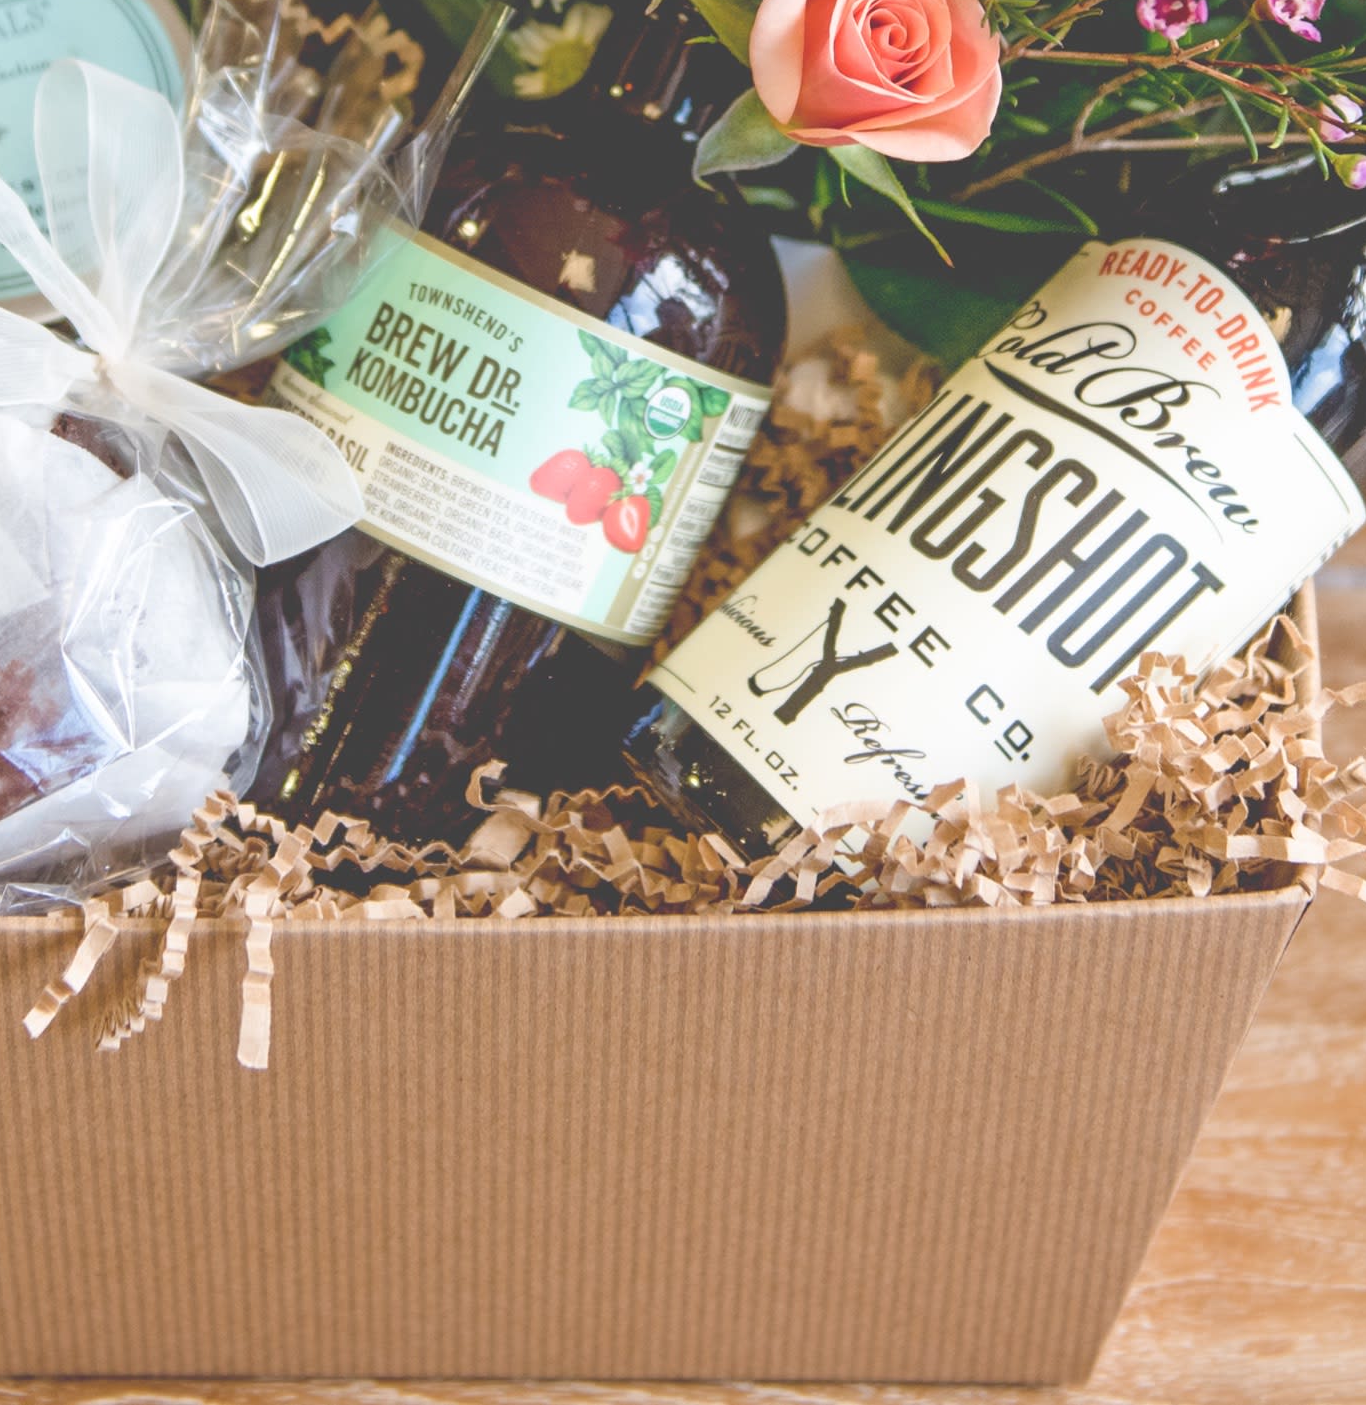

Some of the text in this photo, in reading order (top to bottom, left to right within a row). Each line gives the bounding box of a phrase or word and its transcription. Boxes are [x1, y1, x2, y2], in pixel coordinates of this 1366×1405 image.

[365, 300, 522, 416] BREW DR.
[408, 282, 524, 353] TOWNSHEND'S
[1098, 249, 1283, 413] READY-TO-DRINK
[1124, 289, 1217, 372] COFFEE
[345, 347, 505, 458] KOMBUCHA
[1074, 367, 1260, 534] Brew
[720, 595, 777, 648] licious
[788, 521, 952, 670] OFFEE
[708, 695, 799, 792] 12 FL. OZ.
